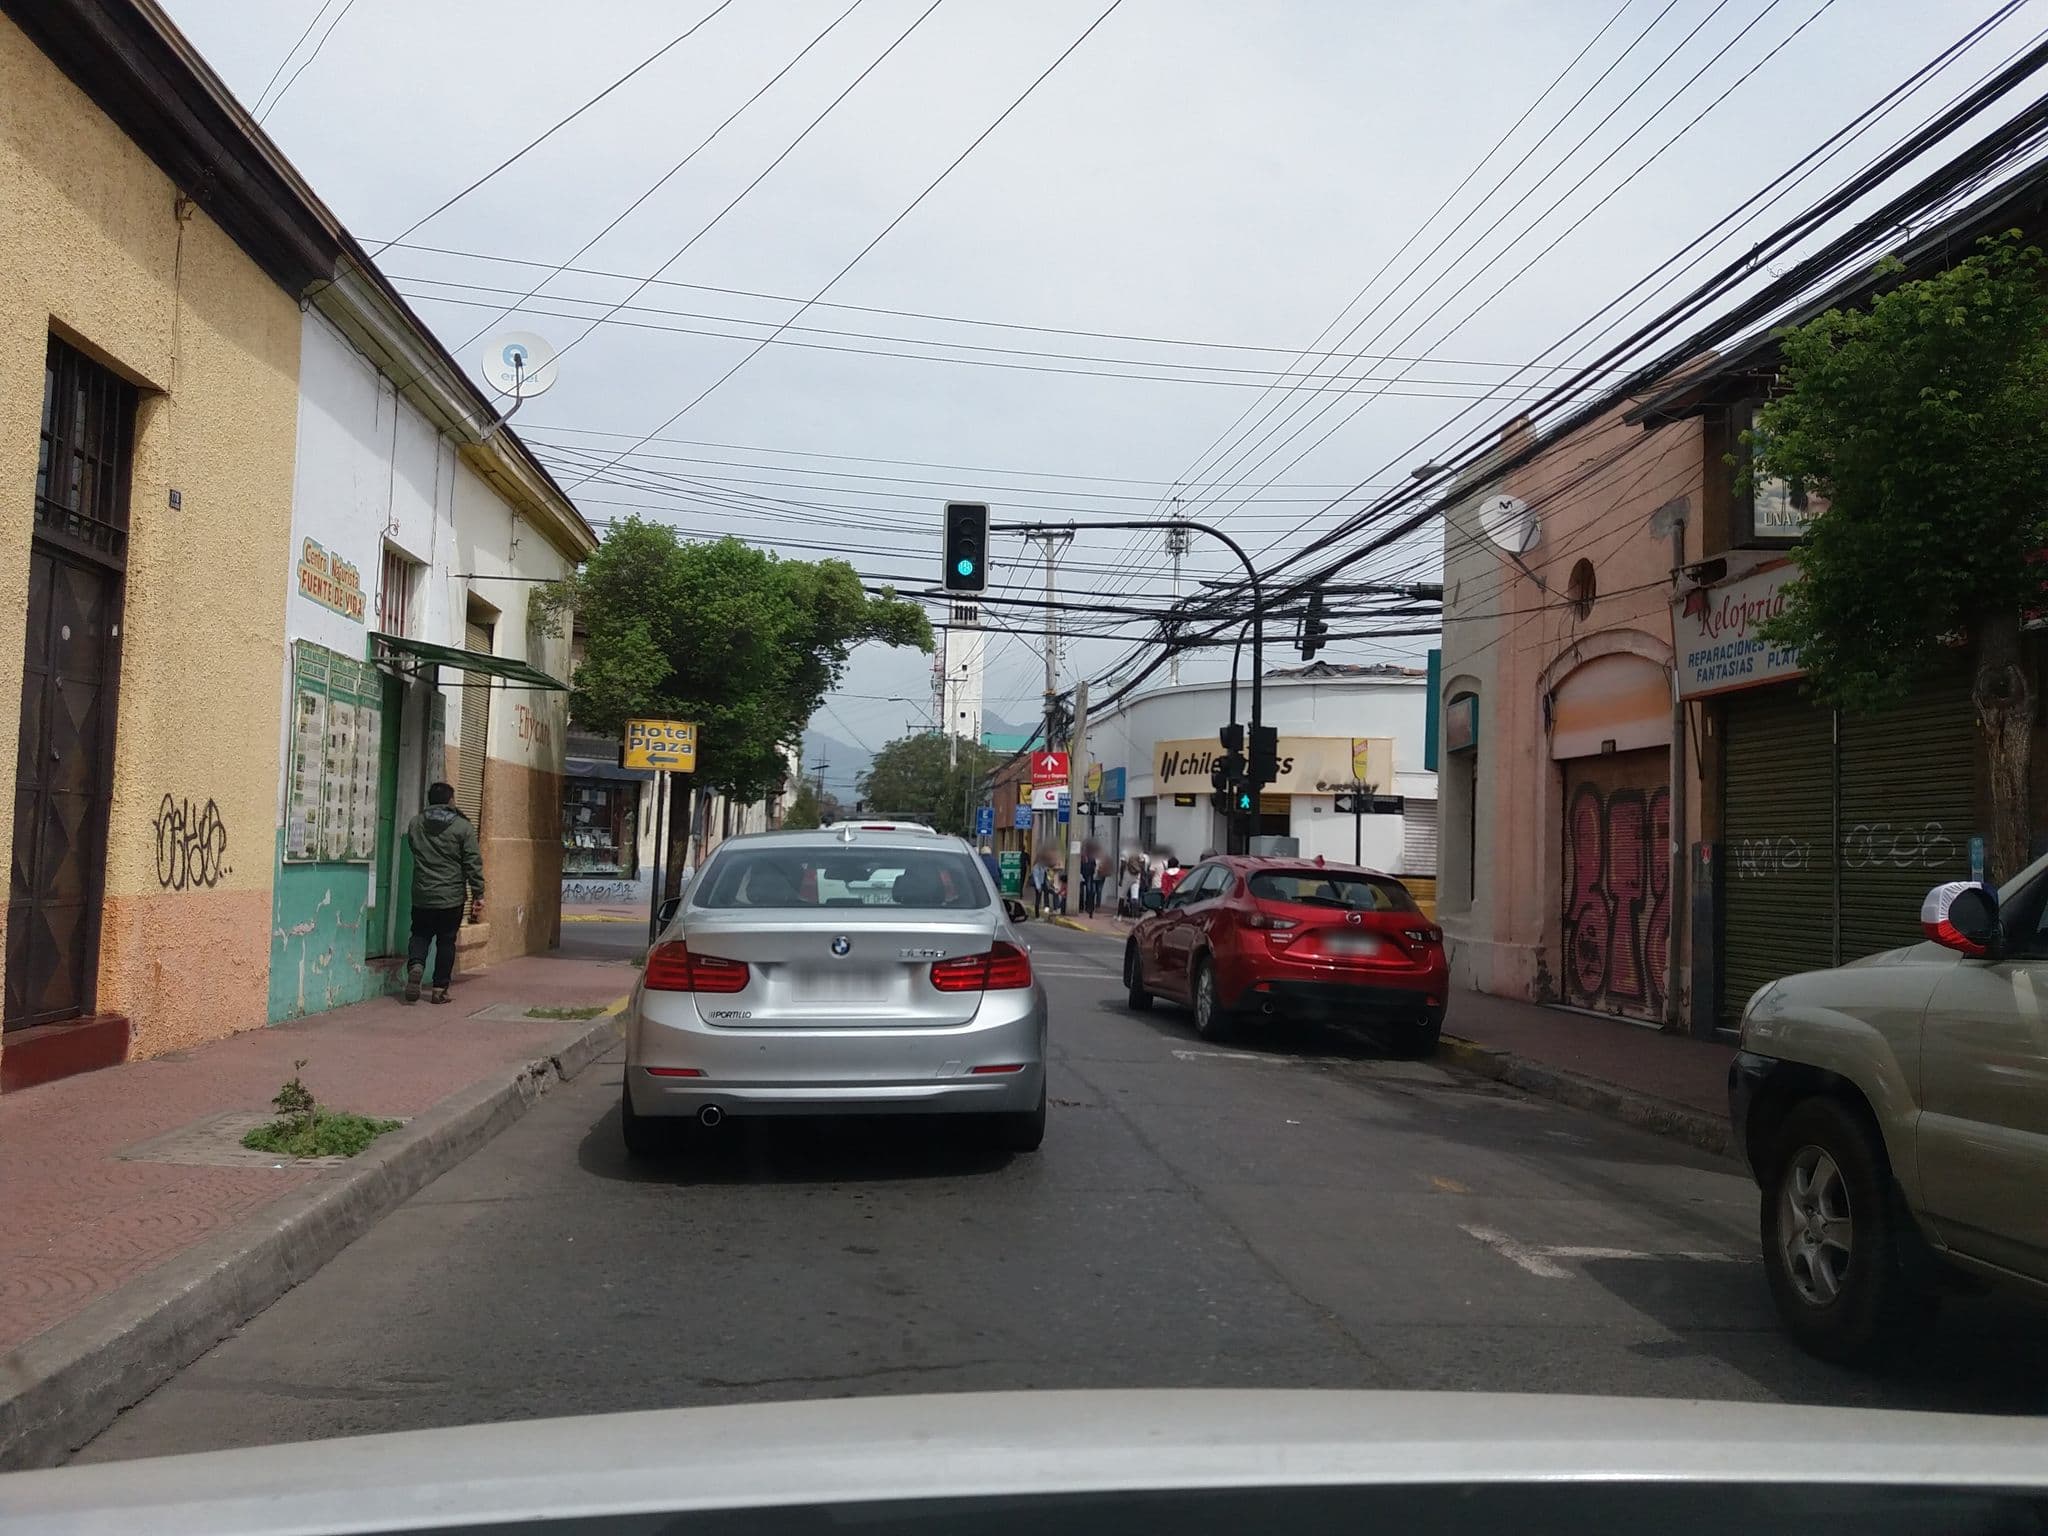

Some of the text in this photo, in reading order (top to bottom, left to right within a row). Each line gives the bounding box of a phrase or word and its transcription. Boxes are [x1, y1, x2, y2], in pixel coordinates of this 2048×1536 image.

[1763, 511, 1792, 527] UNA
[305, 543, 359, 590] Centro Naturista
[334, 586, 343, 609] DE
[345, 590, 363, 618] VIDA
[1696, 583, 1785, 640] Relojería
[1687, 640, 1765, 668] REPARACIONES
[1696, 656, 1754, 682] FANTASIAS
[629, 724, 693, 741] Hotel
[629, 737, 693, 754] Plaza
